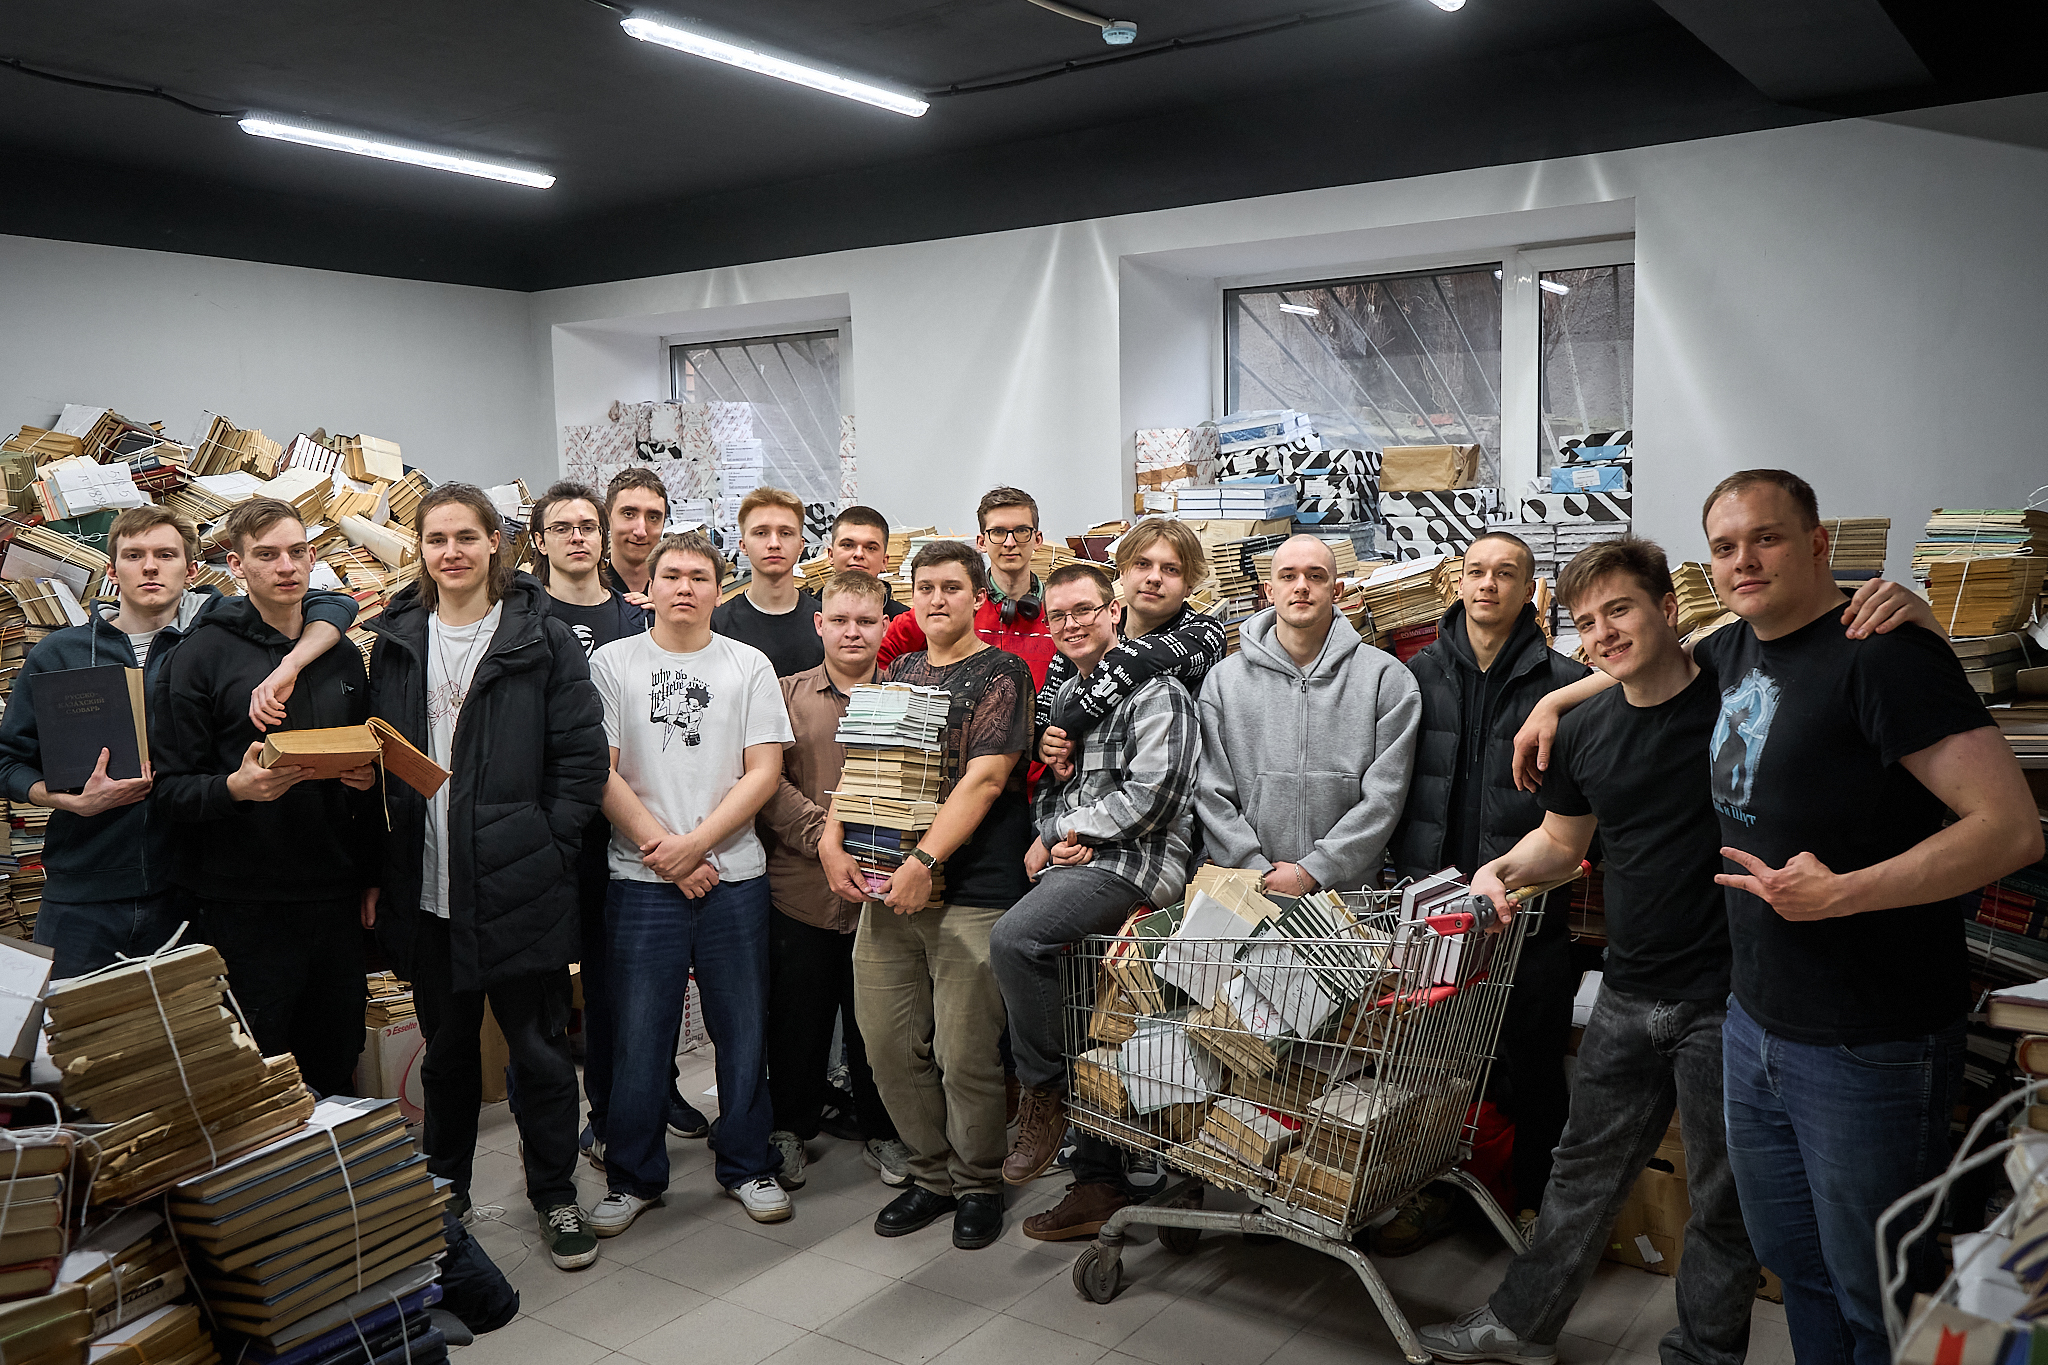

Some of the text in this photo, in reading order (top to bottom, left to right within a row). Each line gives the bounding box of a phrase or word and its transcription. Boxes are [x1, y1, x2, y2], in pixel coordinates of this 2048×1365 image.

[1113, 664, 1133, 687] Palm
[65, 705, 101, 714] СЛОВАРЬ
[391, 1021, 418, 1036] Esselte
